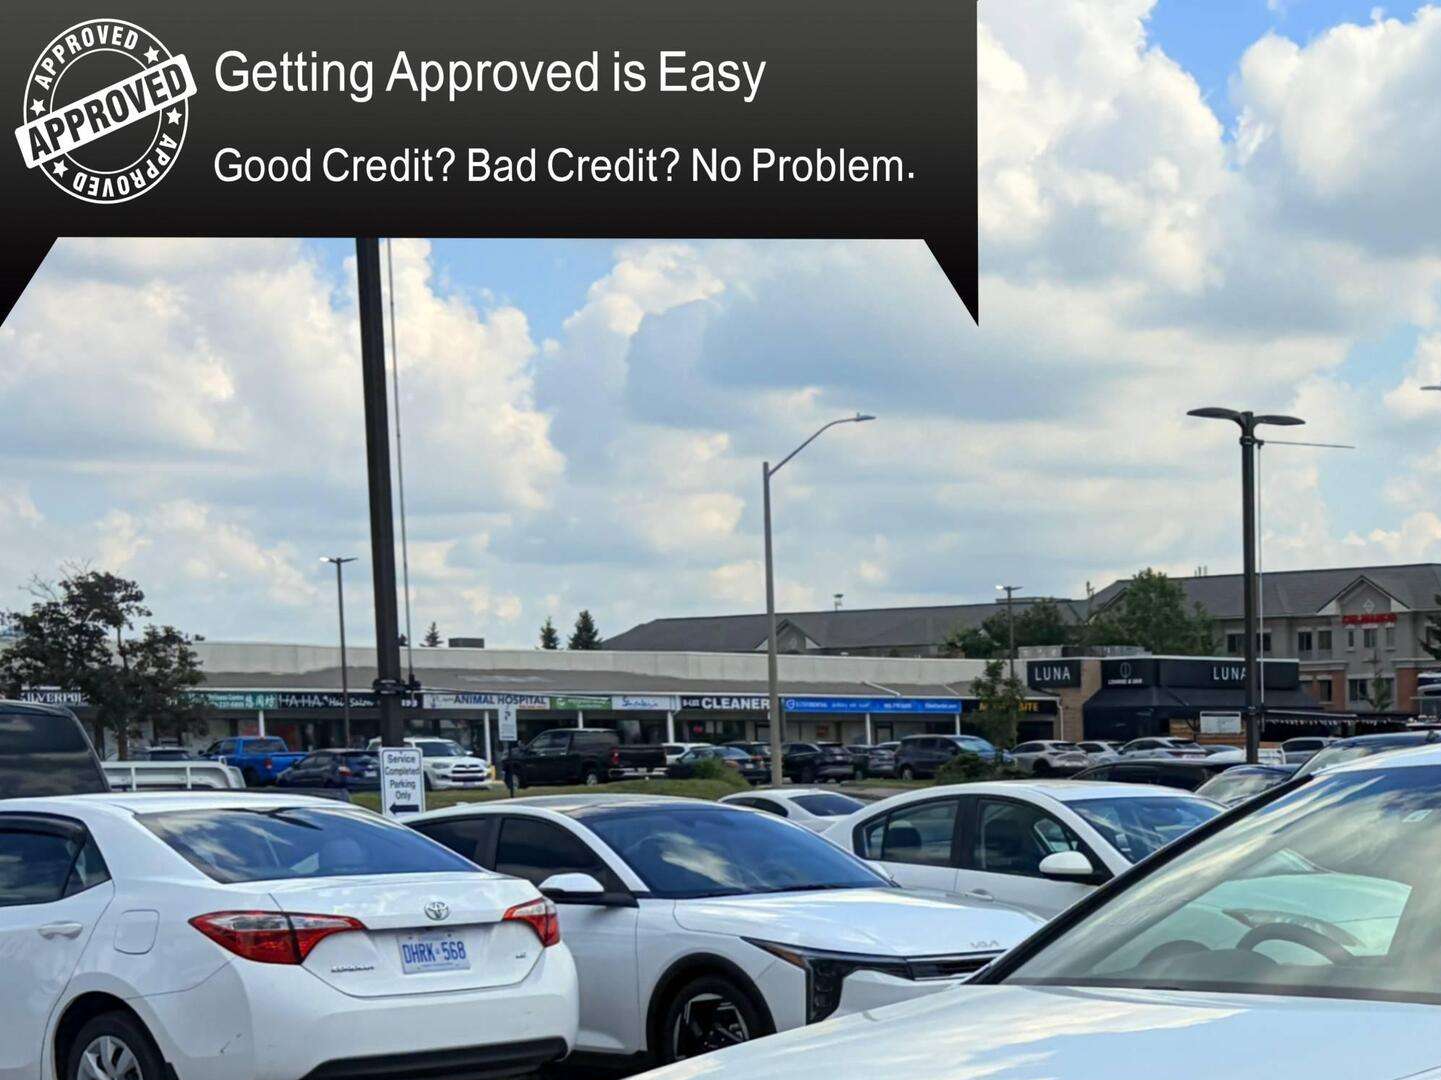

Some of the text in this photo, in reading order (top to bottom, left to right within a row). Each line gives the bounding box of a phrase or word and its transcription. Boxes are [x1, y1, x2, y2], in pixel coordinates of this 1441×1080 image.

[1035, 667, 1071, 681] LUNA
[1213, 666, 1247, 680] LUNA
[454, 693, 496, 705] ANIMAL
[498, 694, 546, 705] HOSPITAL
[387, 754, 415, 763] Service
[385, 766, 420, 776] Completed
[390, 780, 416, 790] Parking
[395, 790, 412, 801] Only
[402, 941, 467, 964] DHRK 568
